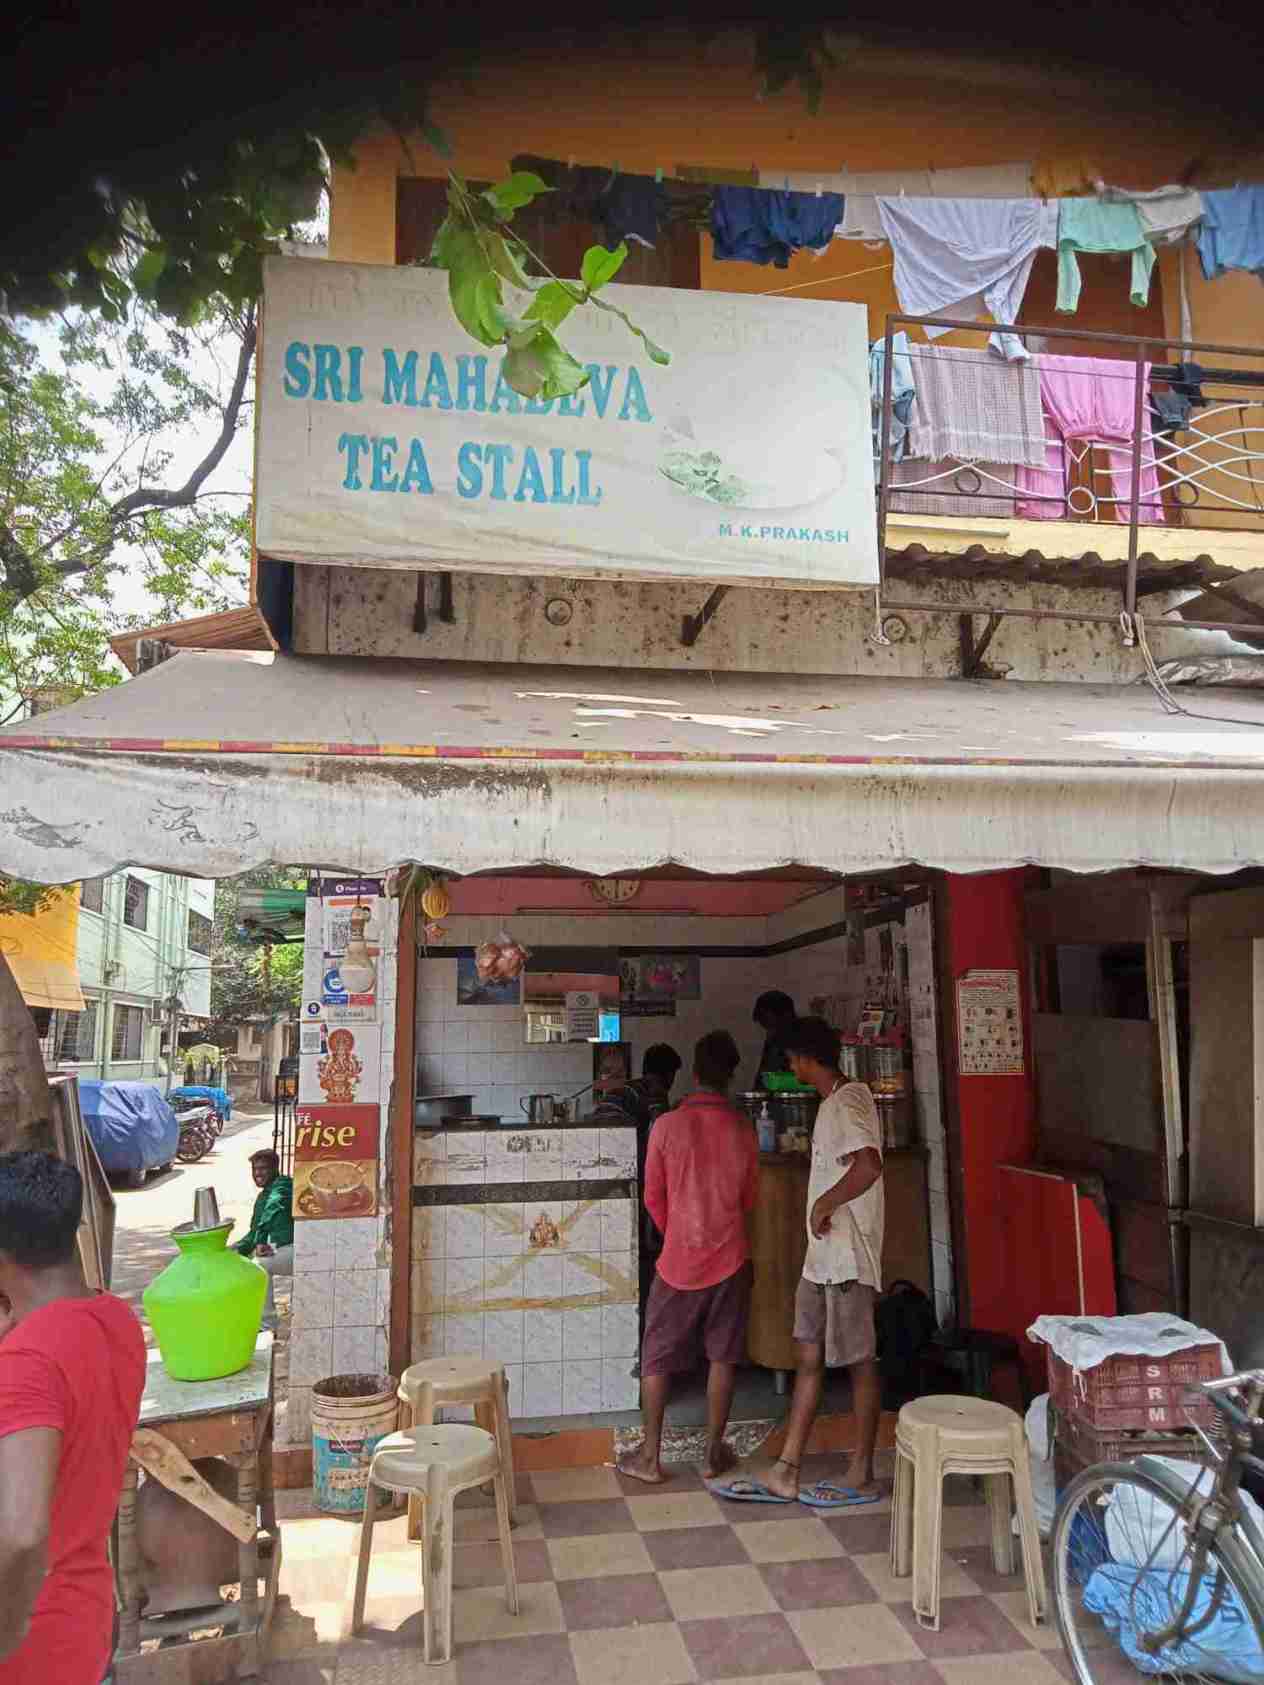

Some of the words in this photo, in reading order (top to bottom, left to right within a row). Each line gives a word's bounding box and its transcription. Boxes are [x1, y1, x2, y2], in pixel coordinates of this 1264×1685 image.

[285, 341, 364, 402] SRI
[383, 348, 653, 423] MAHAVA
[338, 432, 433, 494] TEA
[457, 441, 603, 506] STALL
[296, 1120, 356, 1148] rise
